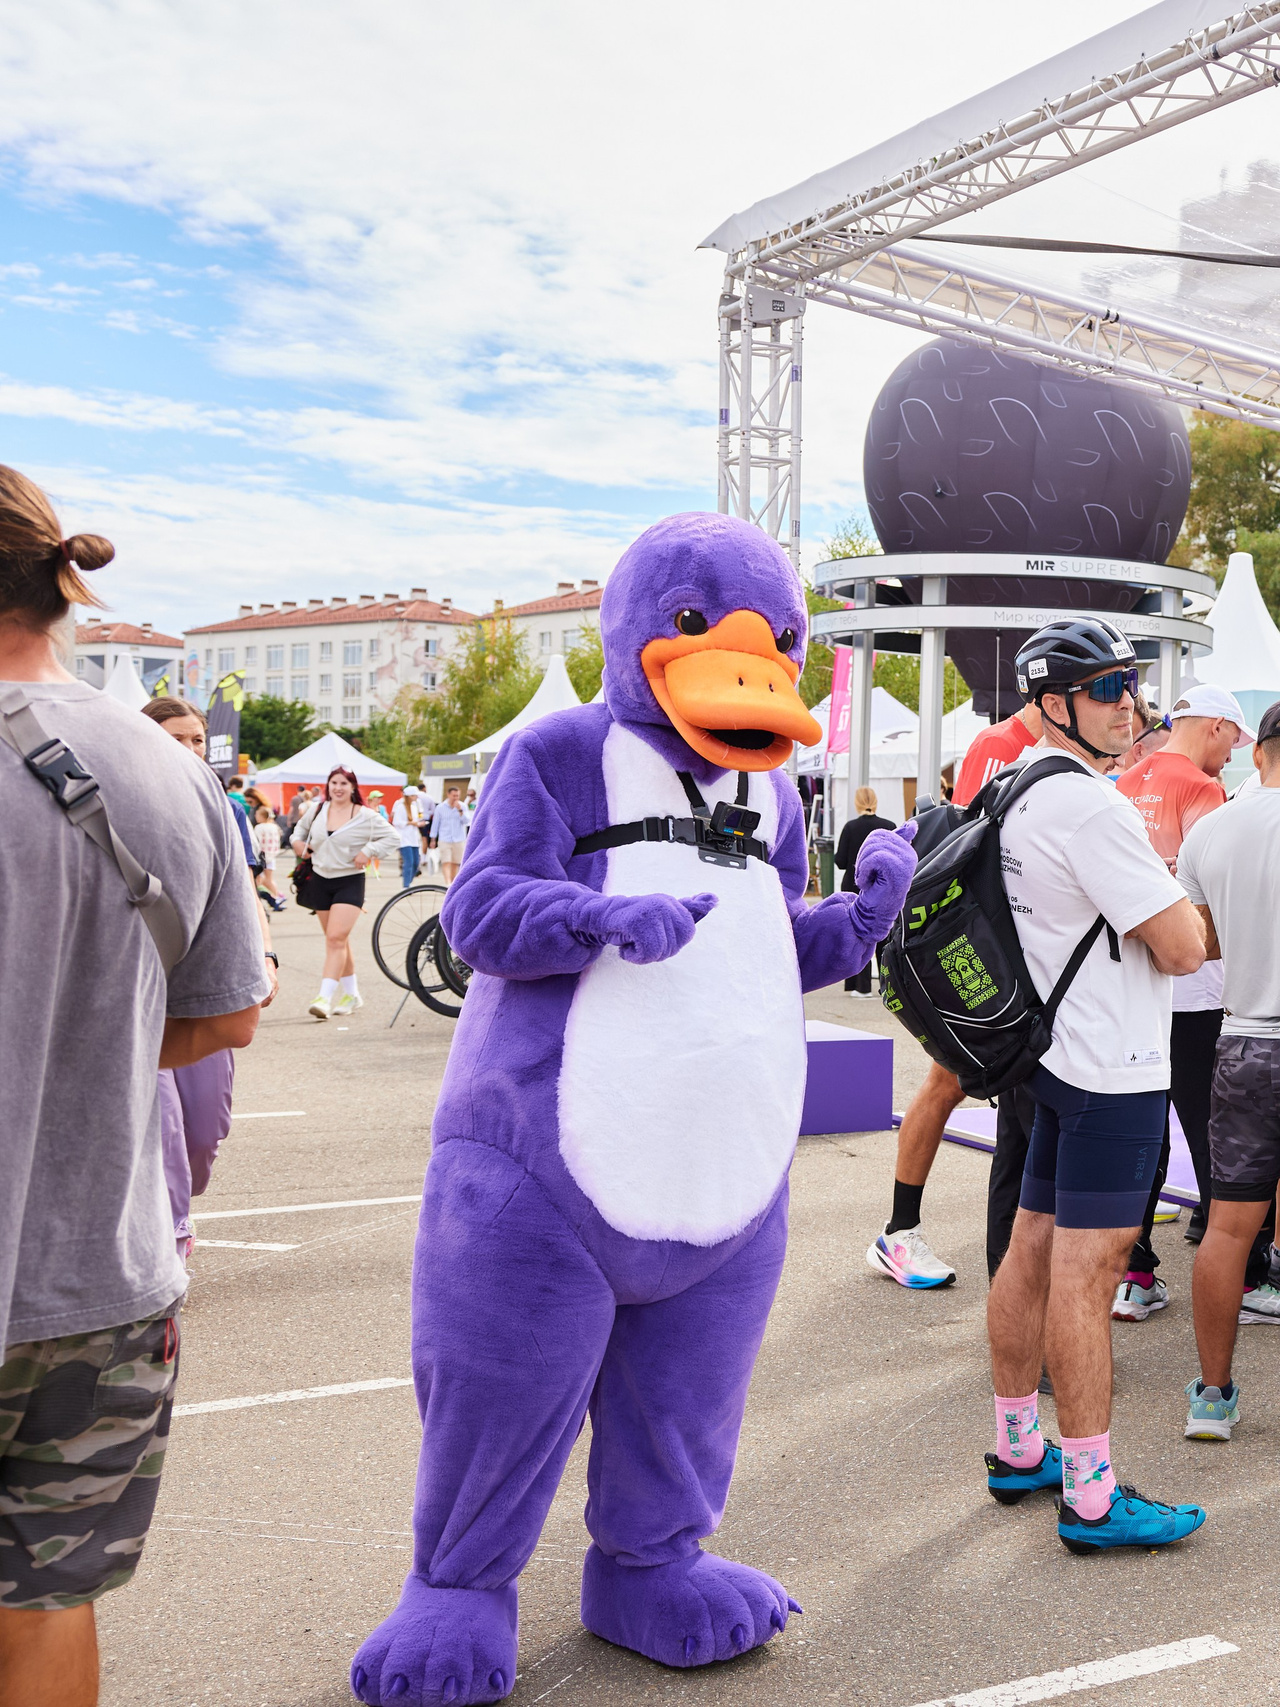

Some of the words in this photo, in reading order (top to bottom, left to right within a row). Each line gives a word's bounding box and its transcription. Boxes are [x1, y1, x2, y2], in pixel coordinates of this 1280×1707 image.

[1026, 560, 1055, 571] MIR
[1060, 560, 1142, 579] SUPREME
[993, 611, 1023, 624] Мир
[1138, 619, 1160, 631] тебя
[1030, 666, 1045, 676] 2132
